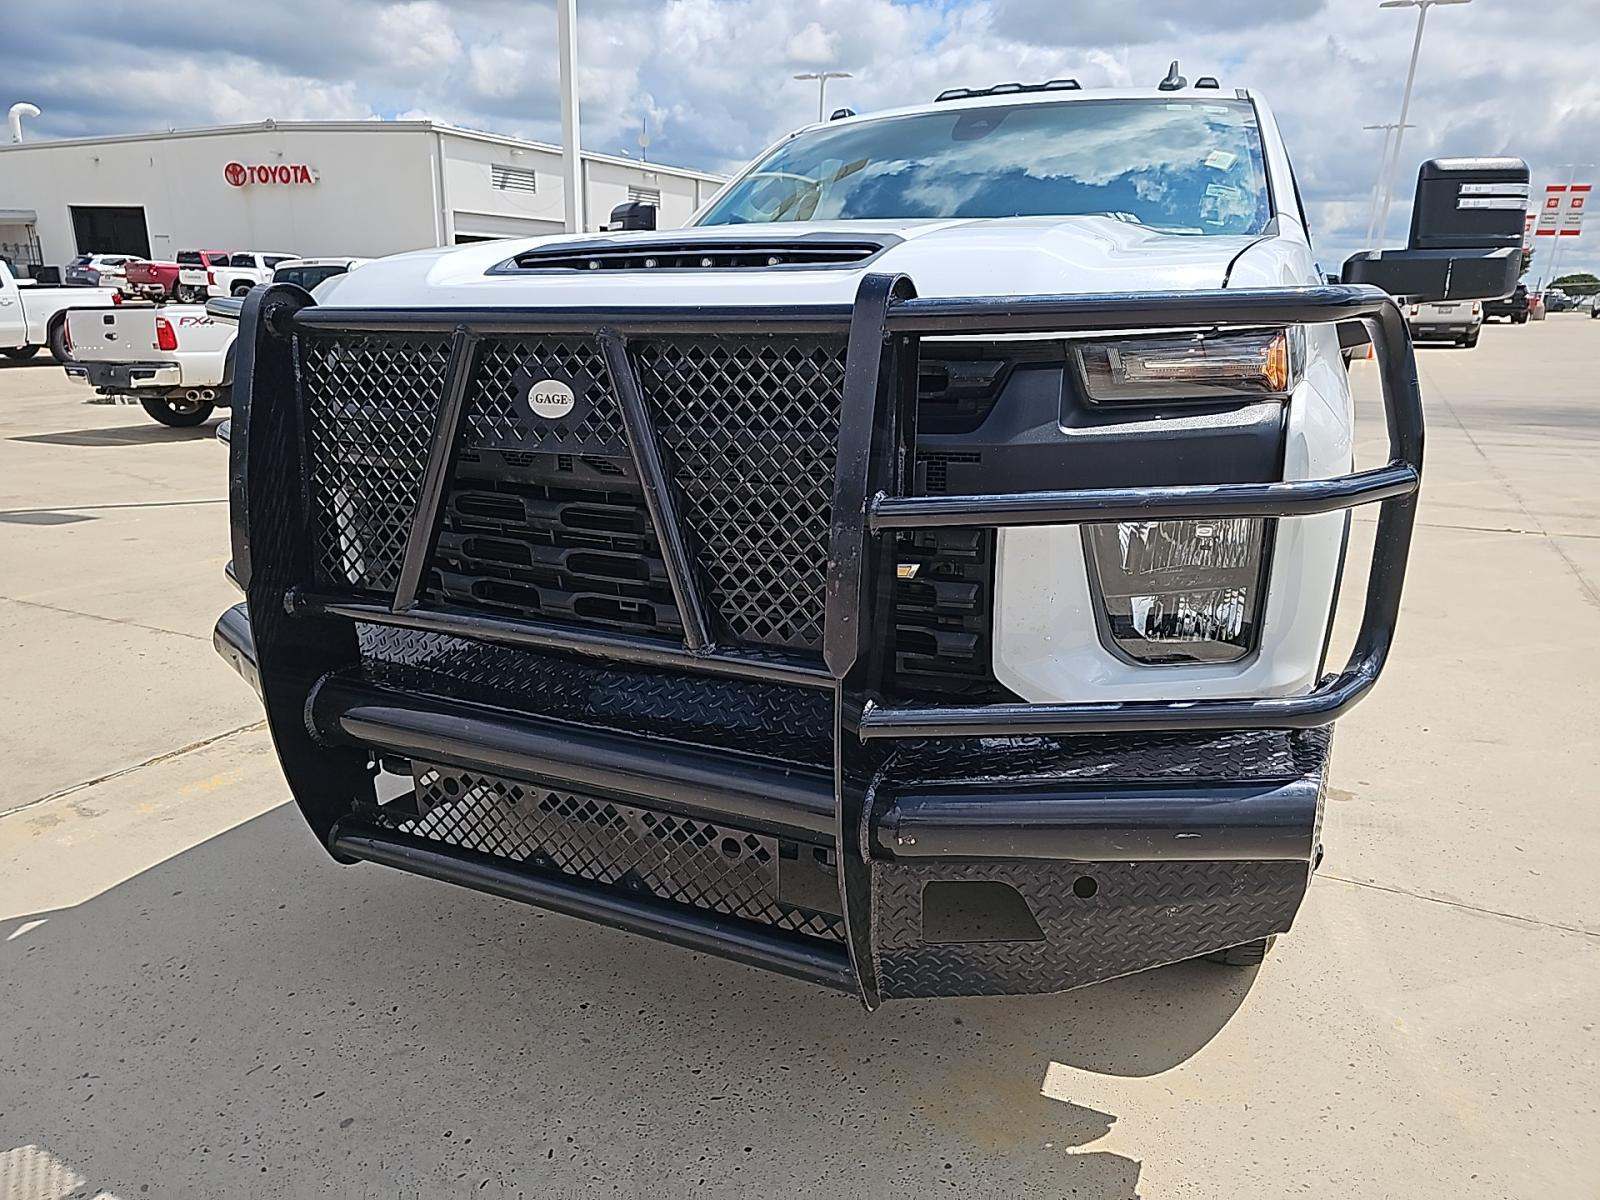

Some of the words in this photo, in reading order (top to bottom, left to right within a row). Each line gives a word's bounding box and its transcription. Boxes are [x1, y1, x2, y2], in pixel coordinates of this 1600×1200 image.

[247, 165, 312, 184] TOYOTA
[179, 316, 214, 327] FX4
[535, 394, 568, 404] GAGE
